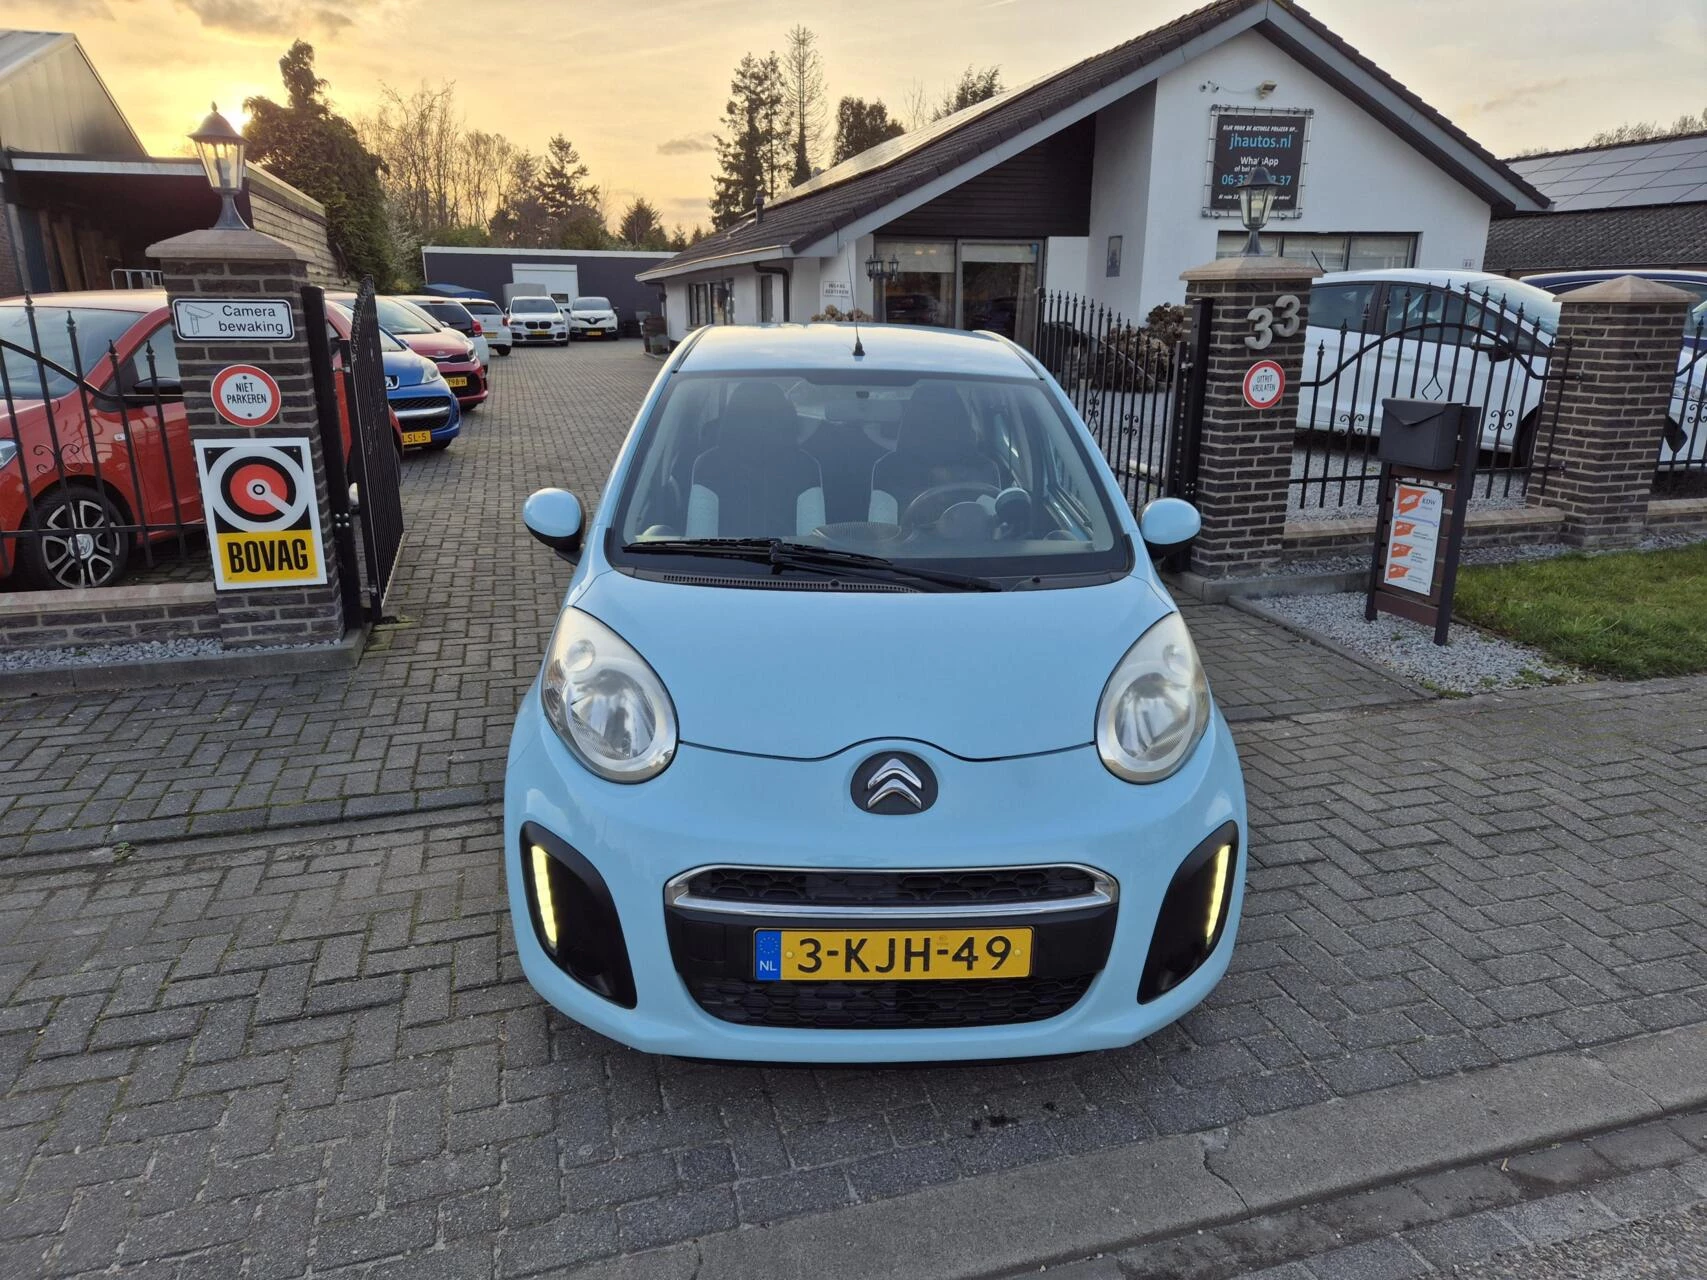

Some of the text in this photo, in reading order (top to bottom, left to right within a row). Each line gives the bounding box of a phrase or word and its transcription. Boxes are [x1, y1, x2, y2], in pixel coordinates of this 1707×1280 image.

[1229, 133, 1292, 150] jhautos.nl
[1240, 156, 1279, 168] WhaApp
[222, 304, 276, 317] Camera
[218, 321, 284, 335] bewaking
[1244, 294, 1301, 350] 33
[235, 382, 254, 393] NIET
[226, 393, 267, 404] PARKEREN
[402, 432, 427, 443] LSL-5
[226, 538, 309, 574] BOVAG
[797, 935, 1012, 974] 3-KJH-49
[759, 960, 777, 972] NL
